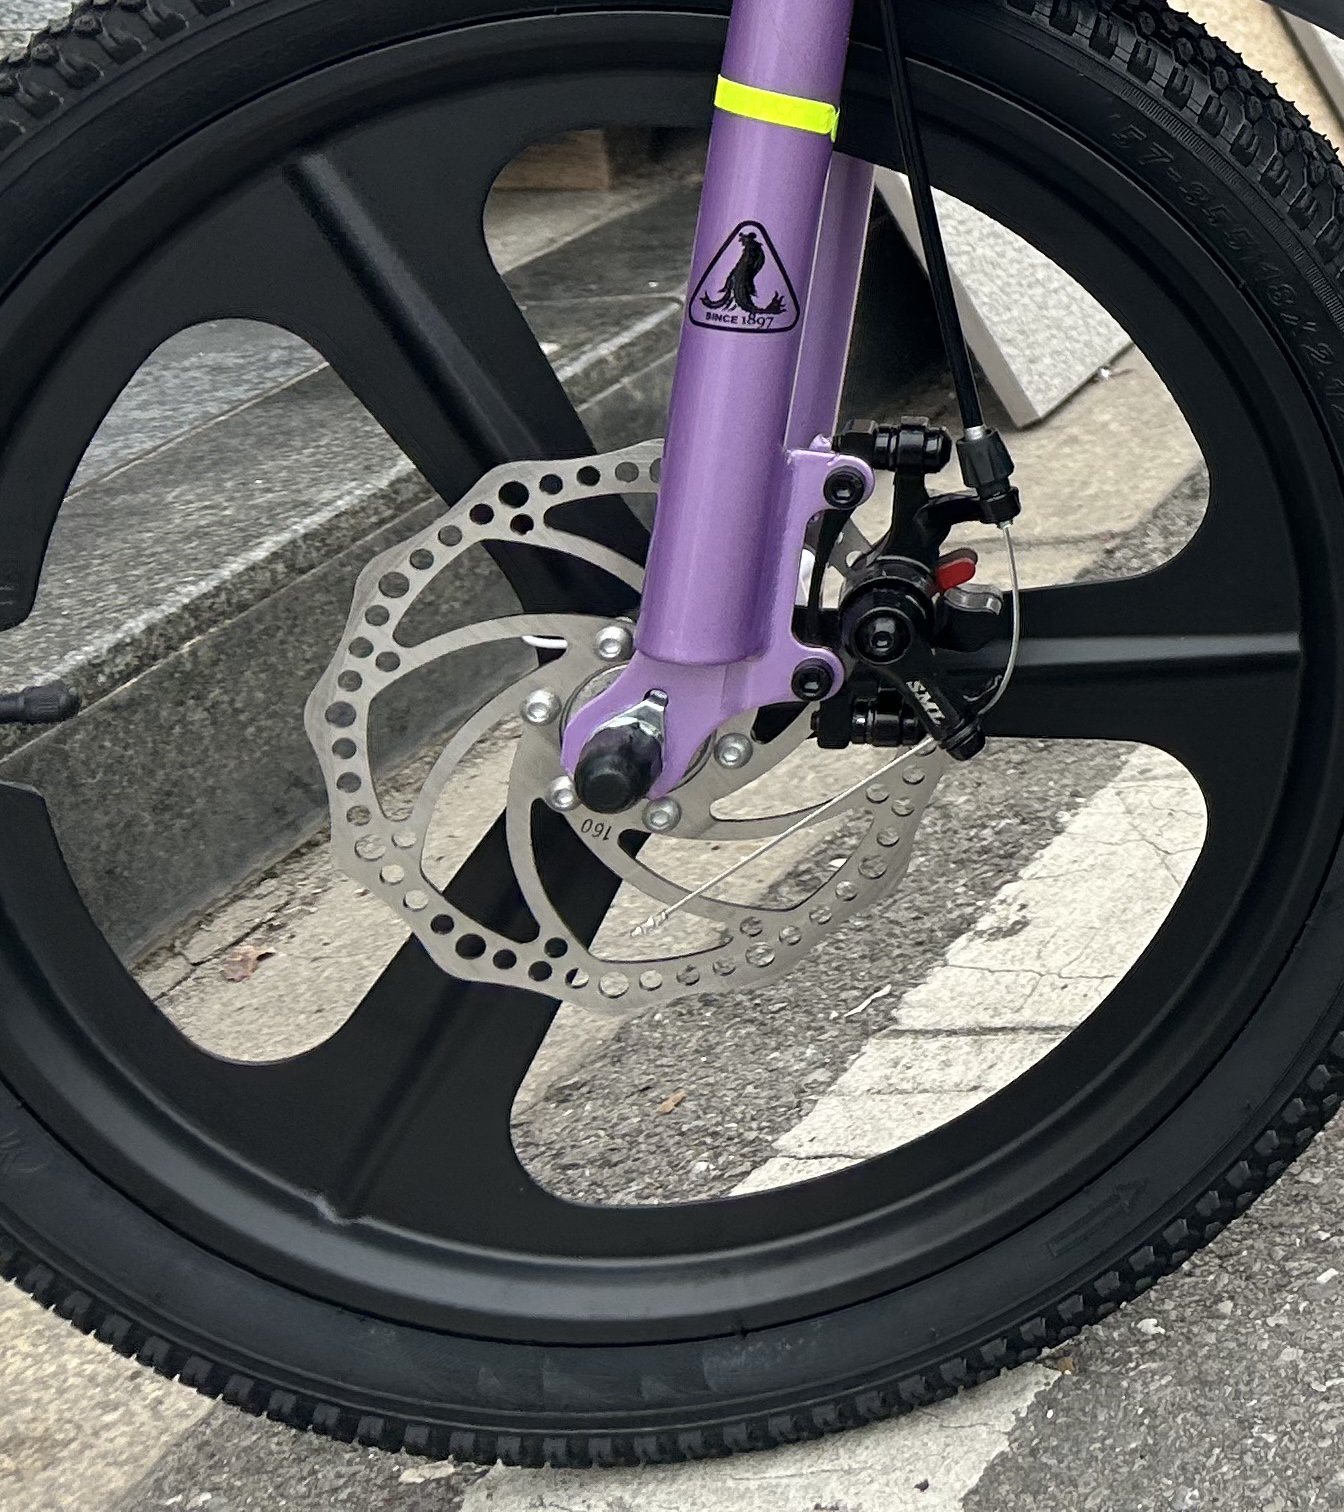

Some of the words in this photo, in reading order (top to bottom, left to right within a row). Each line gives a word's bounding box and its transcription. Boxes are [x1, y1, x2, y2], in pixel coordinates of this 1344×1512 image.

[705, 311, 738, 325] SINCE
[742, 313, 774, 329] 1897
[905, 680, 946, 726] SML
[580, 818, 612, 841] 160
